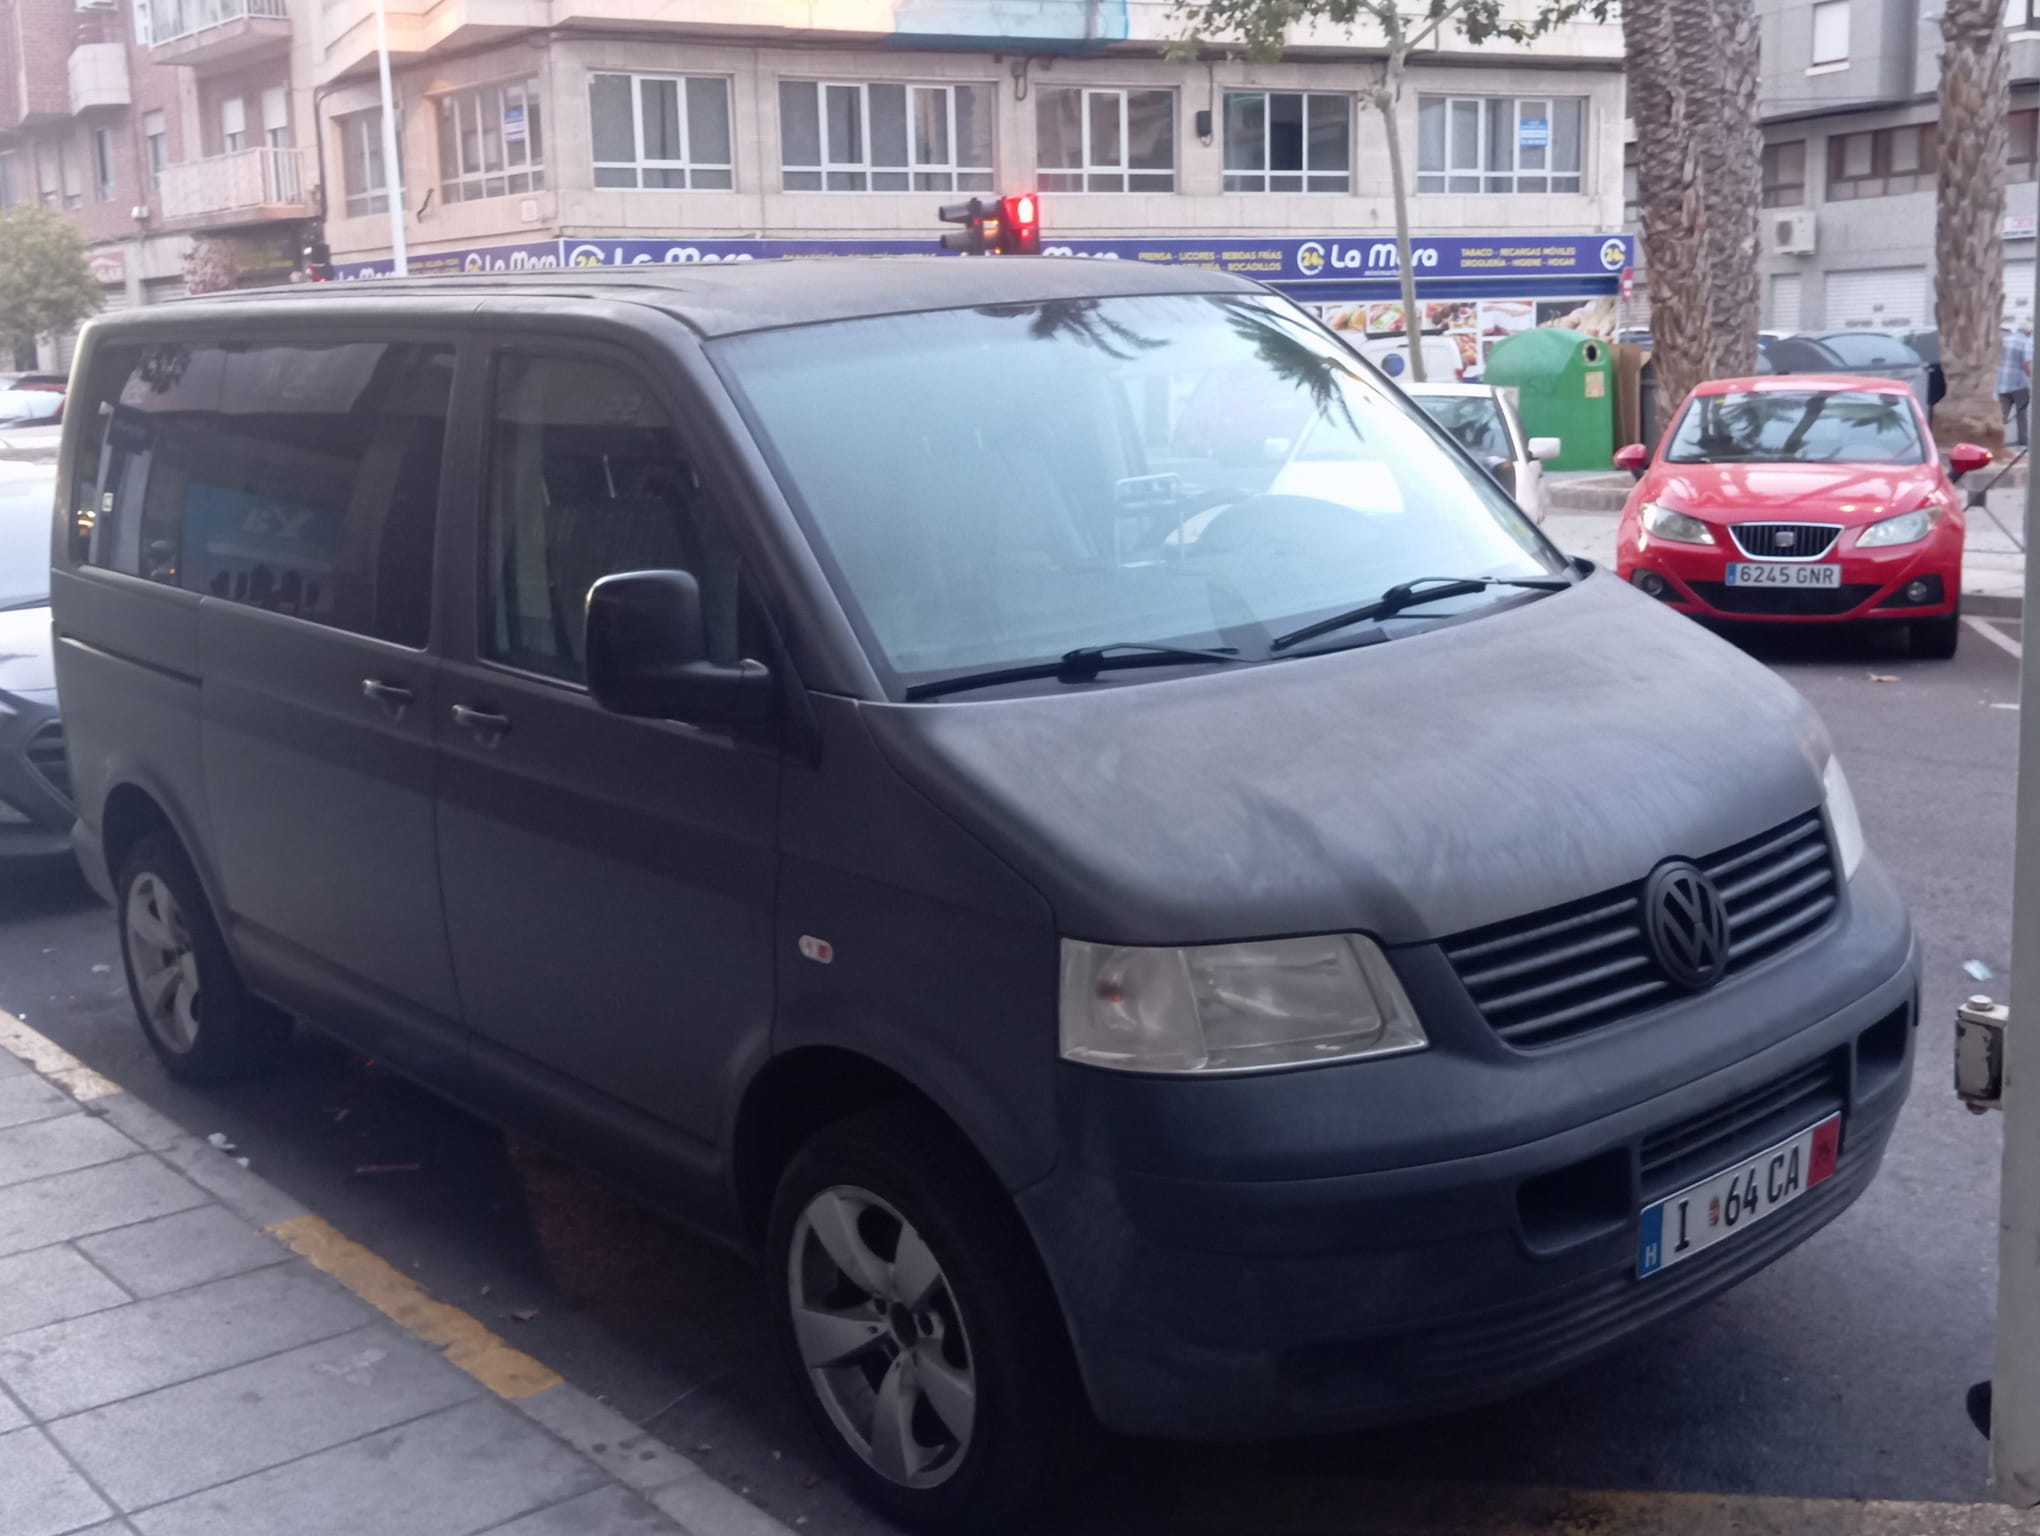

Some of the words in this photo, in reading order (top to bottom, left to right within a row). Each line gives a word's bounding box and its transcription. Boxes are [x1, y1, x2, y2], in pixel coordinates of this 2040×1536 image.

[1139, 251, 1172, 260] PRENSA
[1179, 251, 1215, 260] LICORES
[1222, 251, 1256, 260] BEBIDAS
[1258, 249, 1283, 260] FRÍAS
[1331, 244, 1362, 268] La
[1368, 243, 1438, 268] Mra
[1461, 247, 1493, 257] TABACO
[1500, 247, 1541, 256] RECARGAS
[1228, 262, 1282, 271] BOCADILLOS
[1740, 566, 1790, 584] 6245
[1796, 567, 1834, 585] GNR
[1645, 1242, 1657, 1268] H
[1724, 1166, 1759, 1227] 64
[1766, 1145, 1800, 1204] CA
